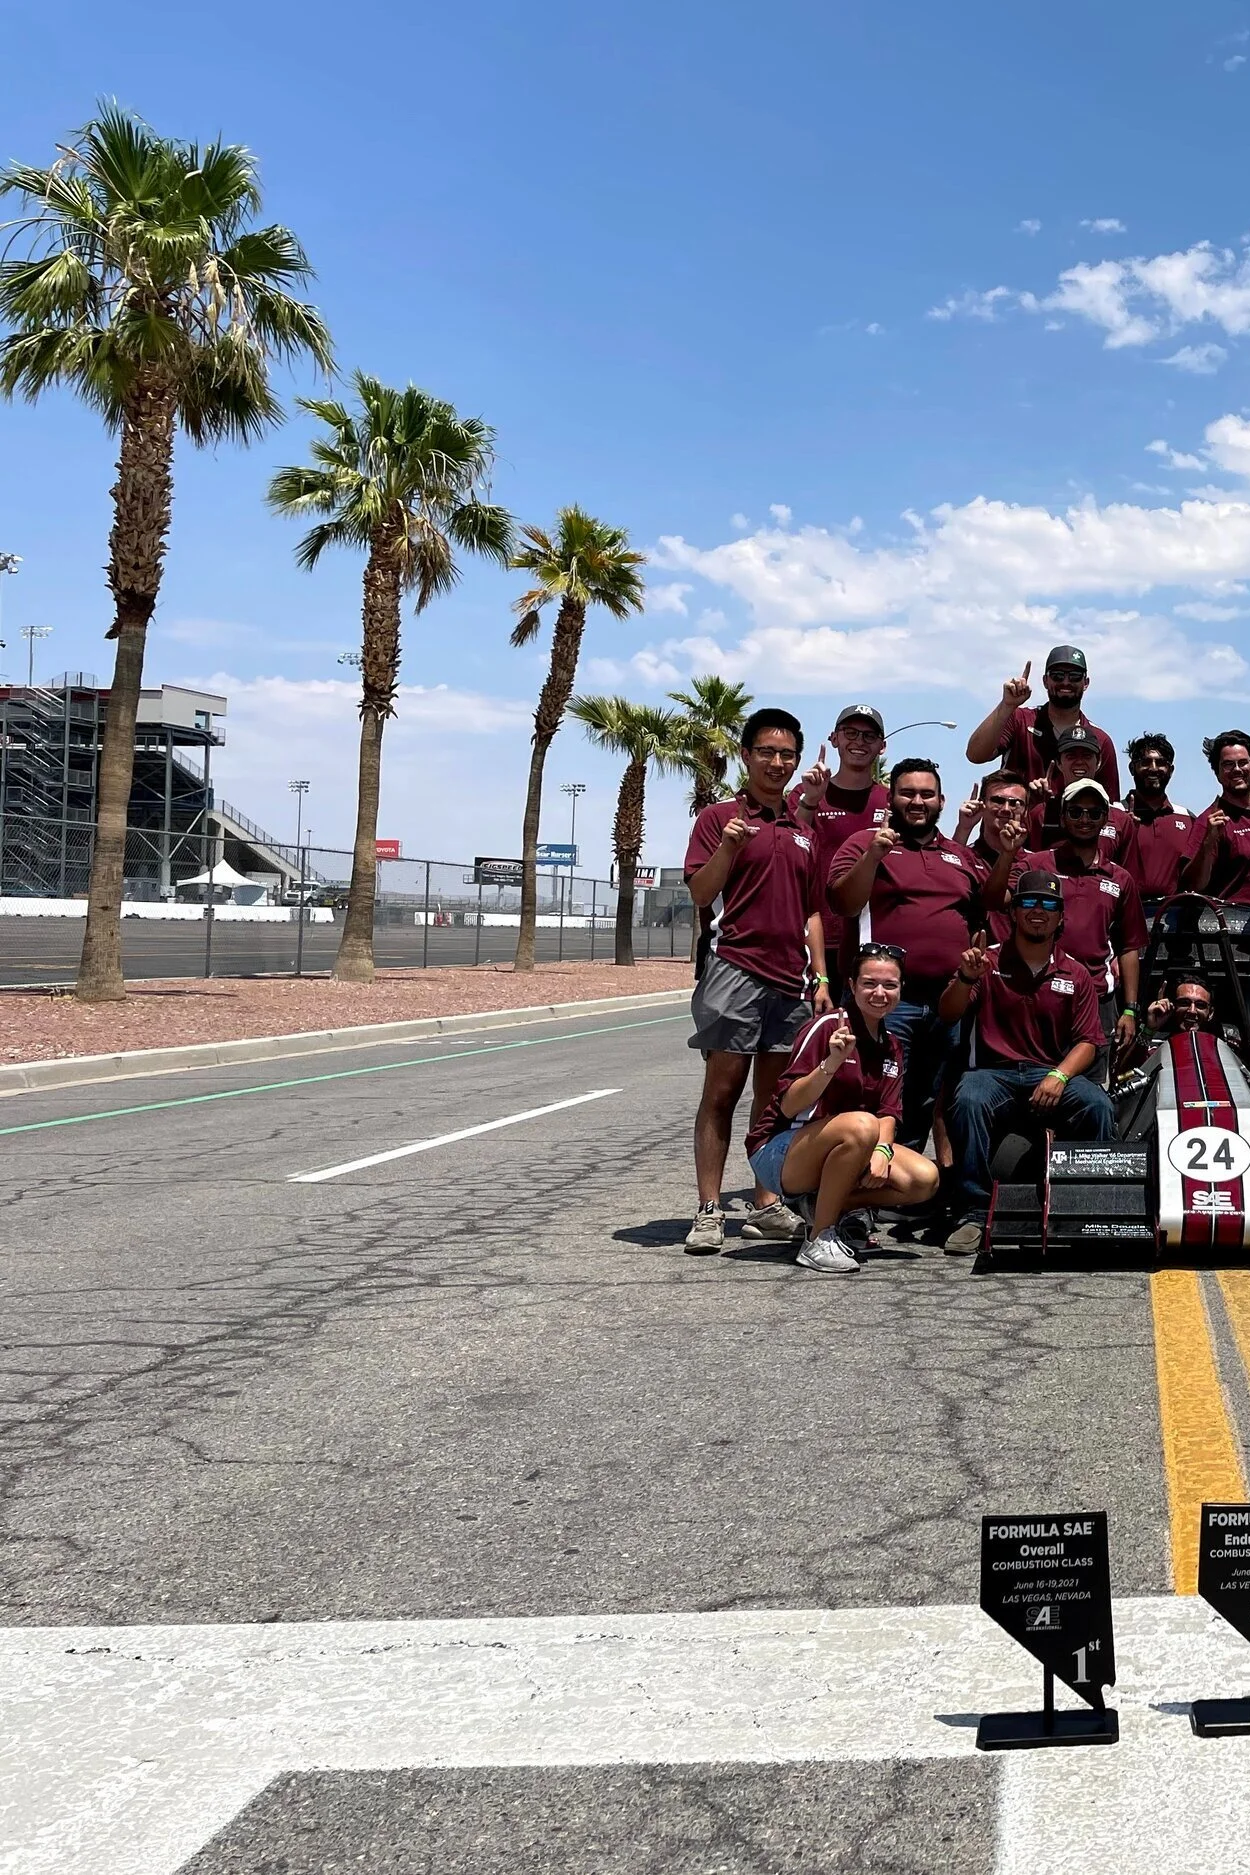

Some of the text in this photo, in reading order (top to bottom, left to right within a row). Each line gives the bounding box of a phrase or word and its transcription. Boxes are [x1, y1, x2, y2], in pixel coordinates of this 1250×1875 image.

[636, 868, 654, 878] IMA
[1186, 1137, 1235, 1170] 24
[989, 1521, 1094, 1539] FORMULA SAE
[1020, 1543, 1065, 1557] Overall
[992, 1557, 1093, 1571] COMBUSTION CLASS
[1231, 1568, 1250, 1576] June
[1014, 1580, 1034, 1589] June
[1220, 1582, 1237, 1590] LAS
[1002, 1595, 1020, 1604] LAS
[1055, 1591, 1091, 1601] NEVADA
